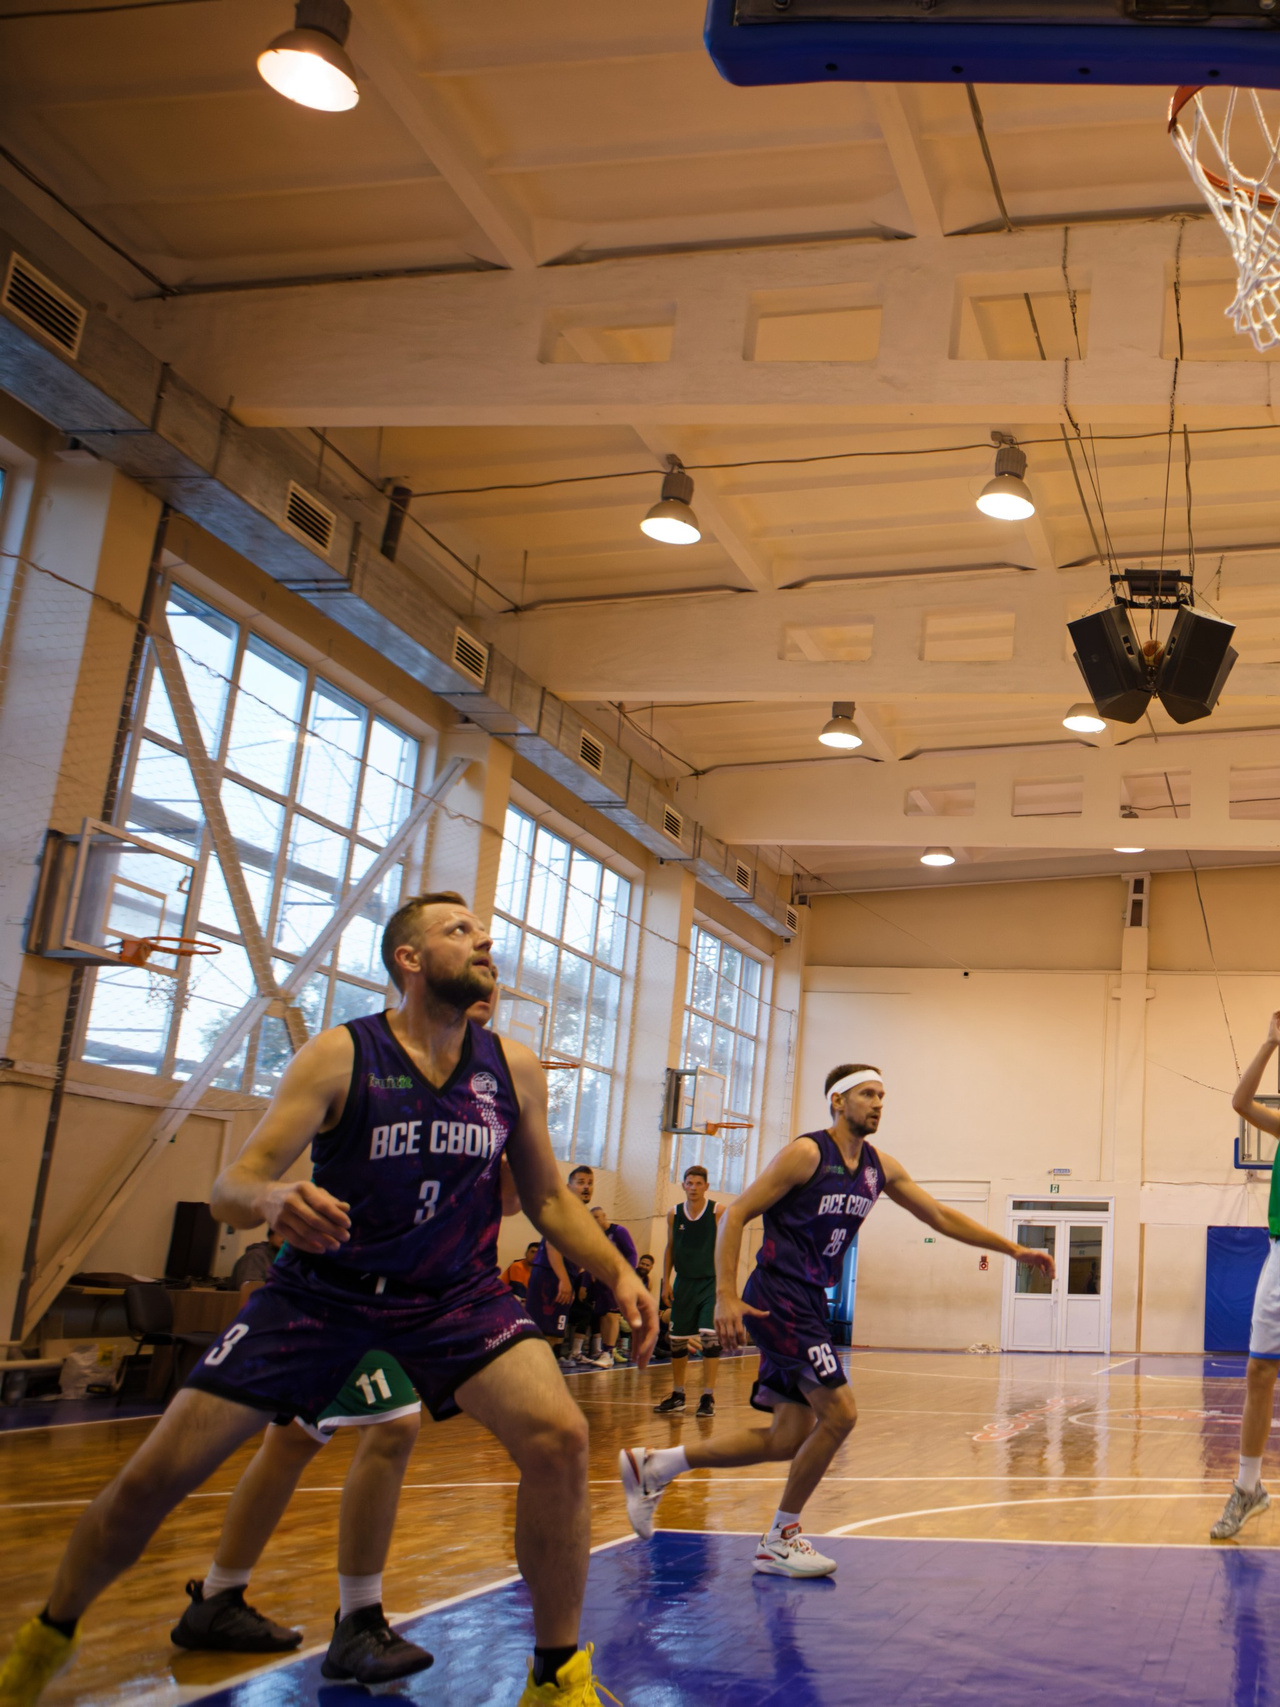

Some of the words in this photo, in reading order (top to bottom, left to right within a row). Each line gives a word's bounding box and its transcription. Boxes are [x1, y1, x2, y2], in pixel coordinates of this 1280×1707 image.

[369, 1120, 422, 1160] ВСЕ
[413, 1180, 441, 1224] 3
[818, 1194, 846, 1216] ВСЕ
[557, 1315, 566, 1330] 9
[204, 1323, 249, 1366] 3
[808, 1343, 838, 1377] 26
[355, 1368, 392, 1405] 11
